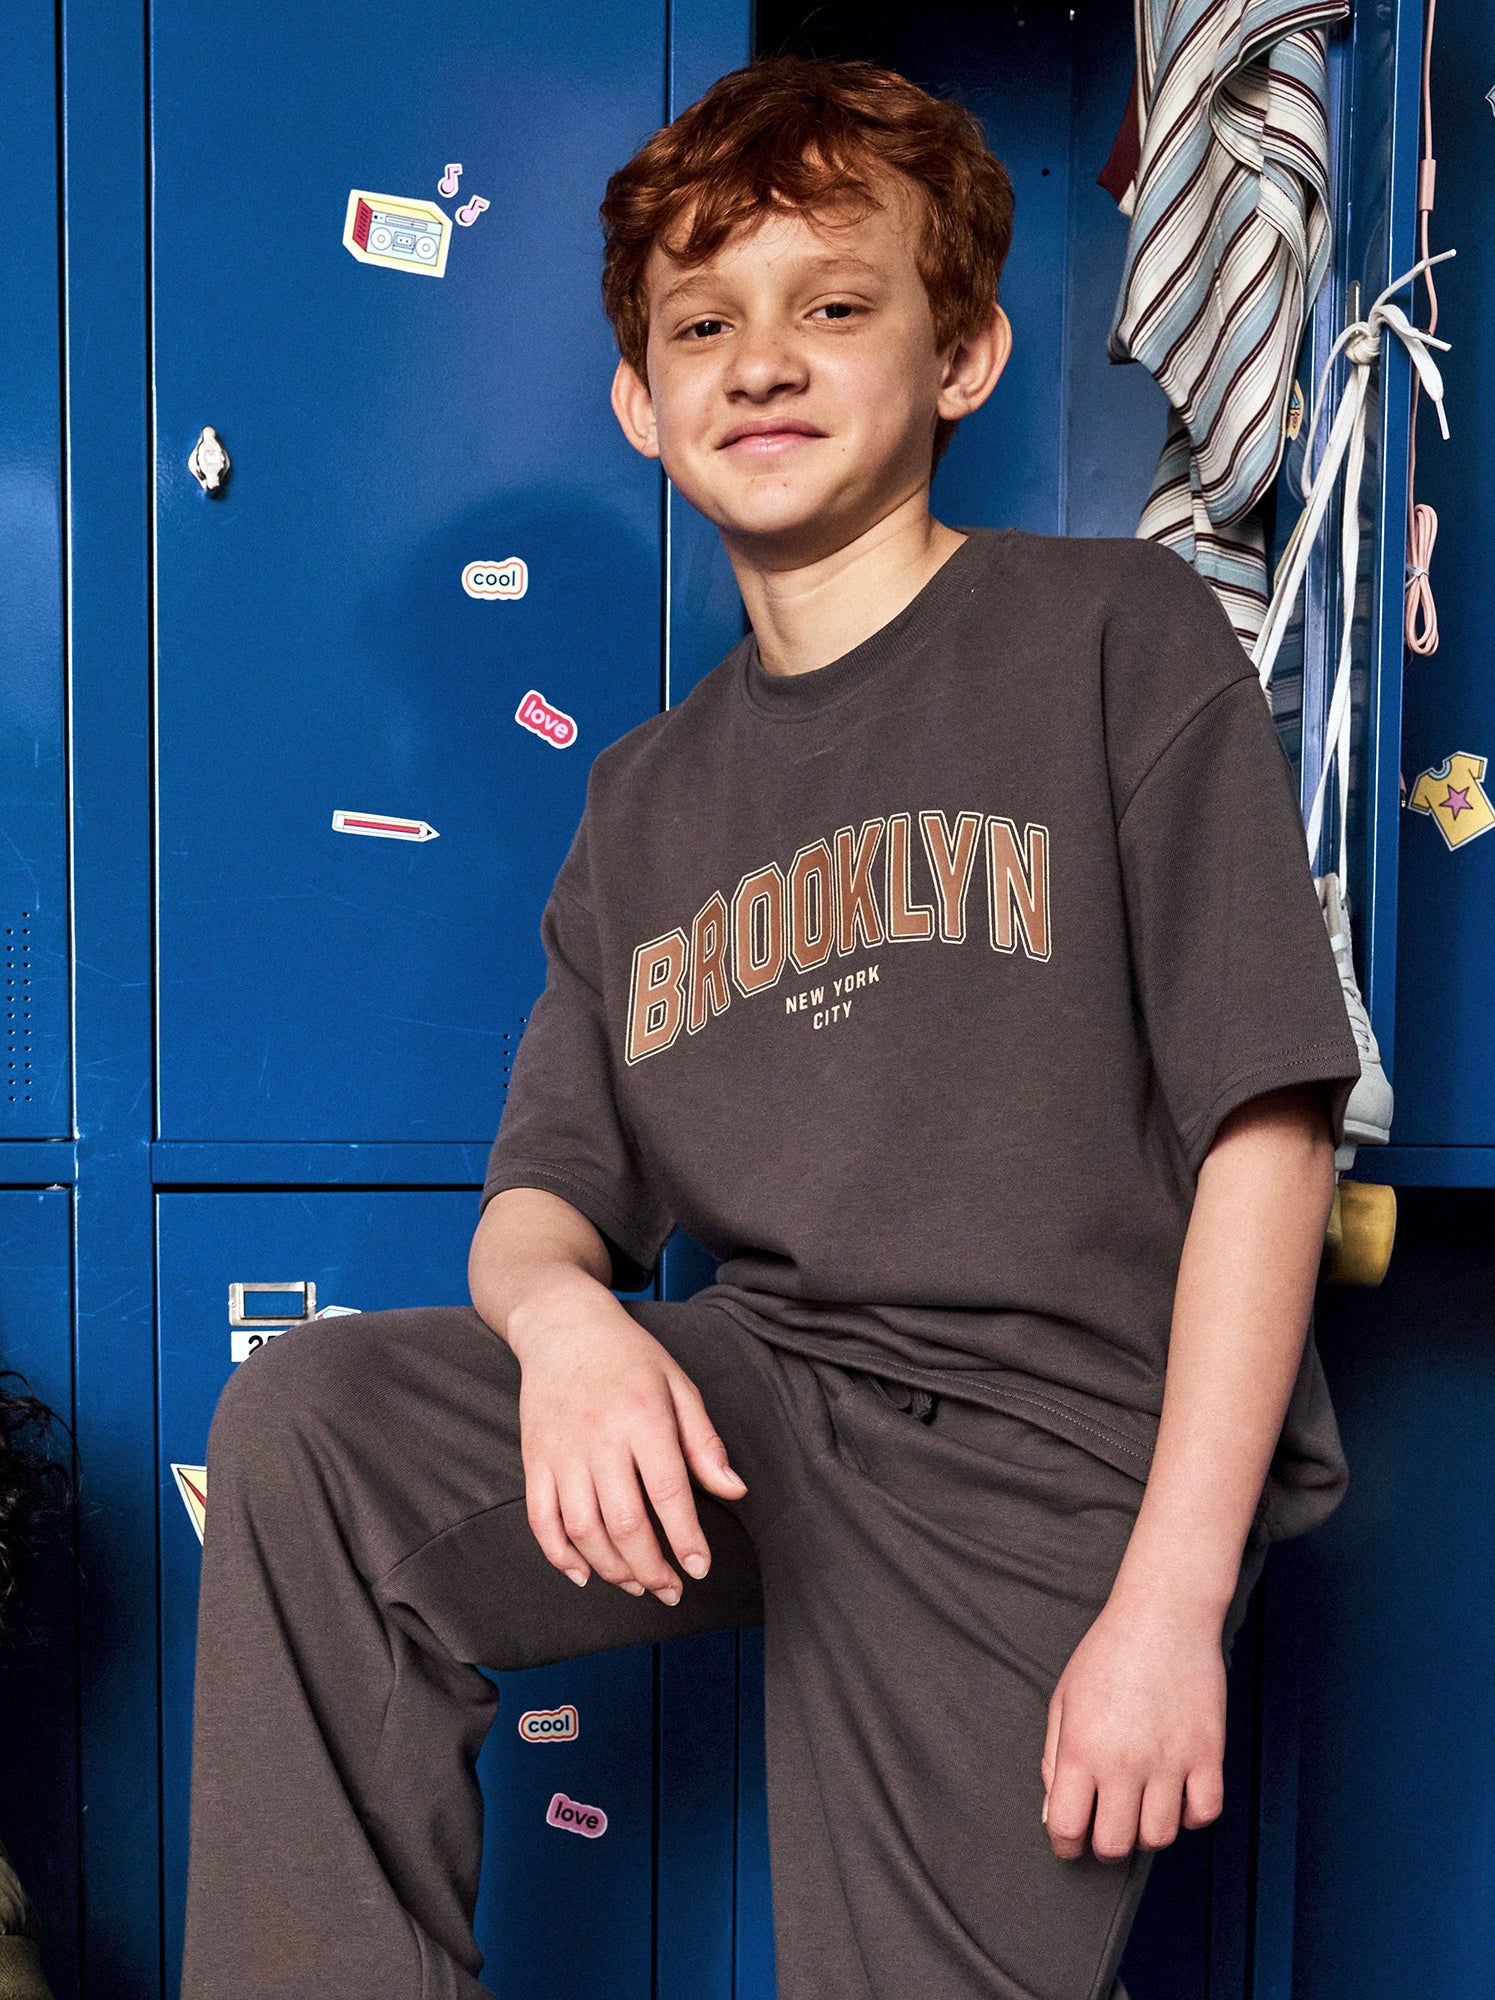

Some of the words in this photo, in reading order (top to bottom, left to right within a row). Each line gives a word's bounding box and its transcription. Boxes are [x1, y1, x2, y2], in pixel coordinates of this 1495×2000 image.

[473, 570, 516, 587] cool
[523, 700, 569, 739] love
[624, 809, 1051, 1067] BROOKLYN
[785, 986, 825, 1015] NEW
[833, 964, 880, 997] YORK
[813, 1000, 852, 1030] CITY
[248, 1334, 277, 1356] 2
[528, 1714, 570, 1733] cool
[554, 1801, 599, 1829] love
